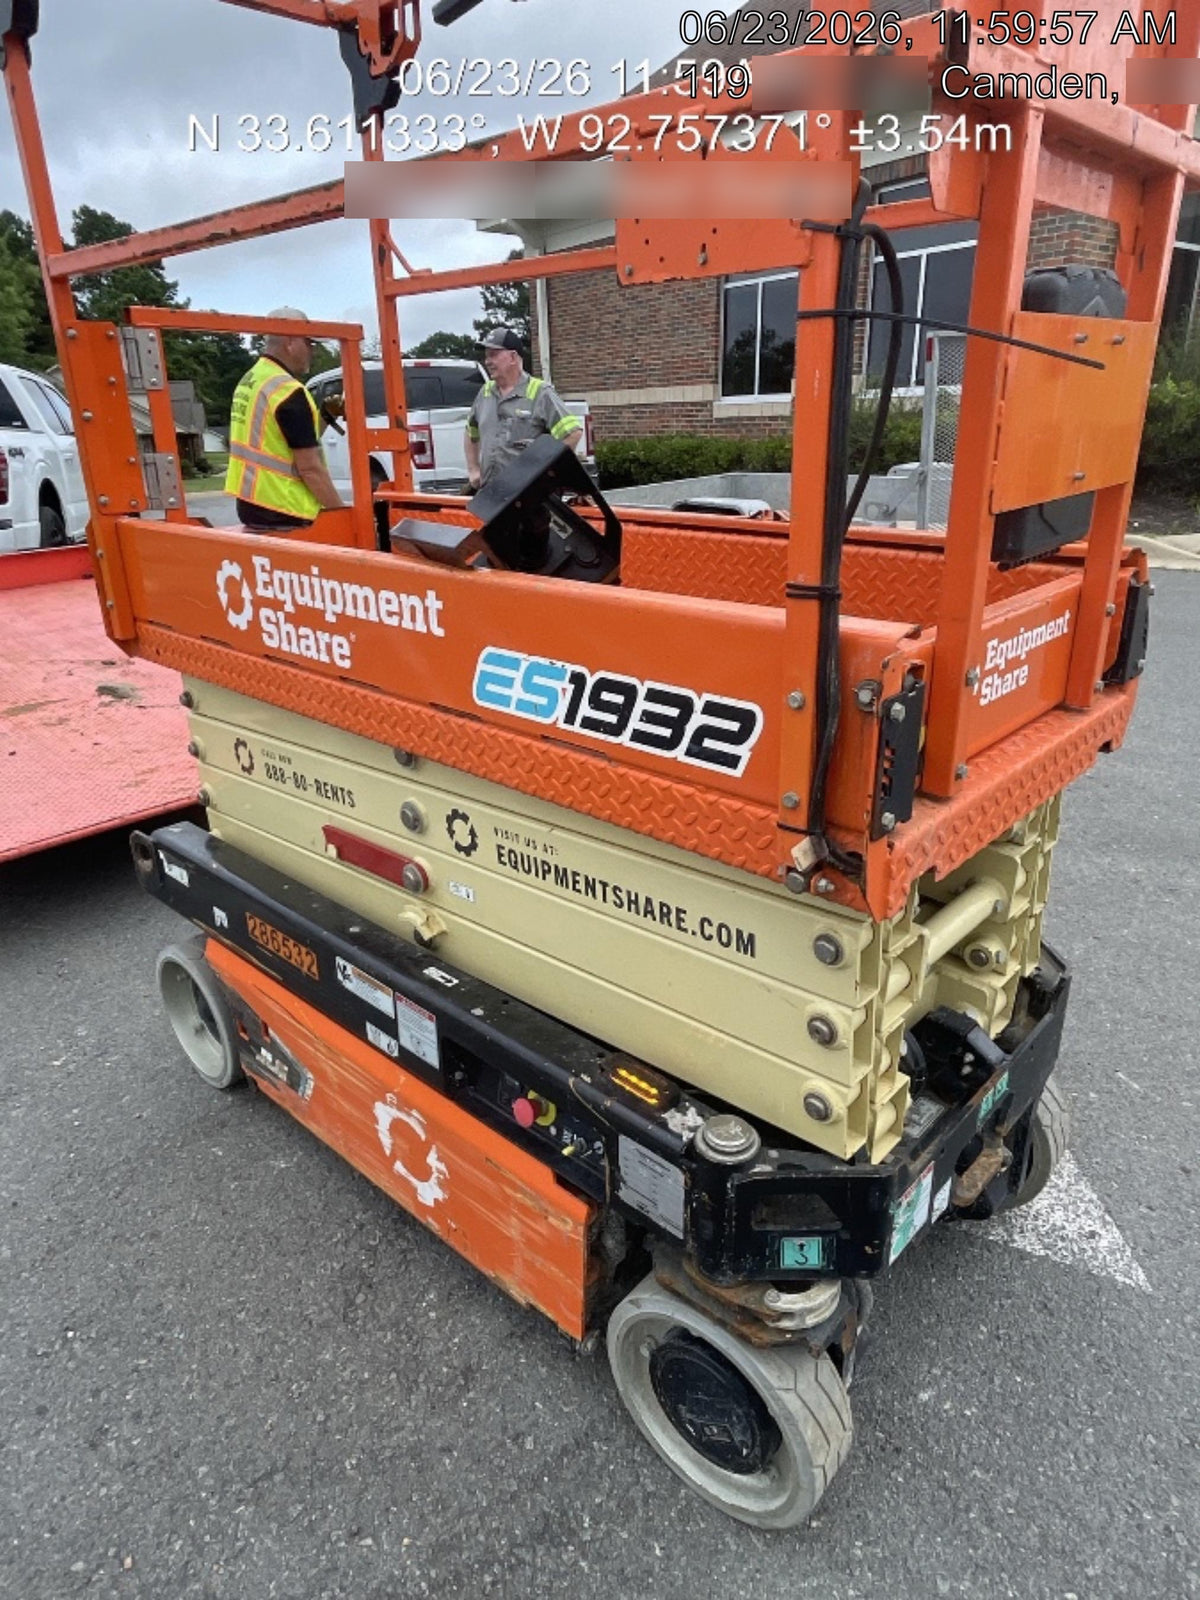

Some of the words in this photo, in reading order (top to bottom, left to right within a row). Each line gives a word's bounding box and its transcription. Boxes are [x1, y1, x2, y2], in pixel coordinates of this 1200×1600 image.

[251, 555, 446, 638] Equipment
[258, 606, 352, 669] Share
[984, 608, 1071, 671] Equipment
[473, 647, 763, 776] ES1932
[979, 664, 1029, 707] Share
[524, 836, 538, 851] US
[495, 843, 758, 960] EQUIPMENTSHARE.COM
[247, 914, 318, 978] 286532
